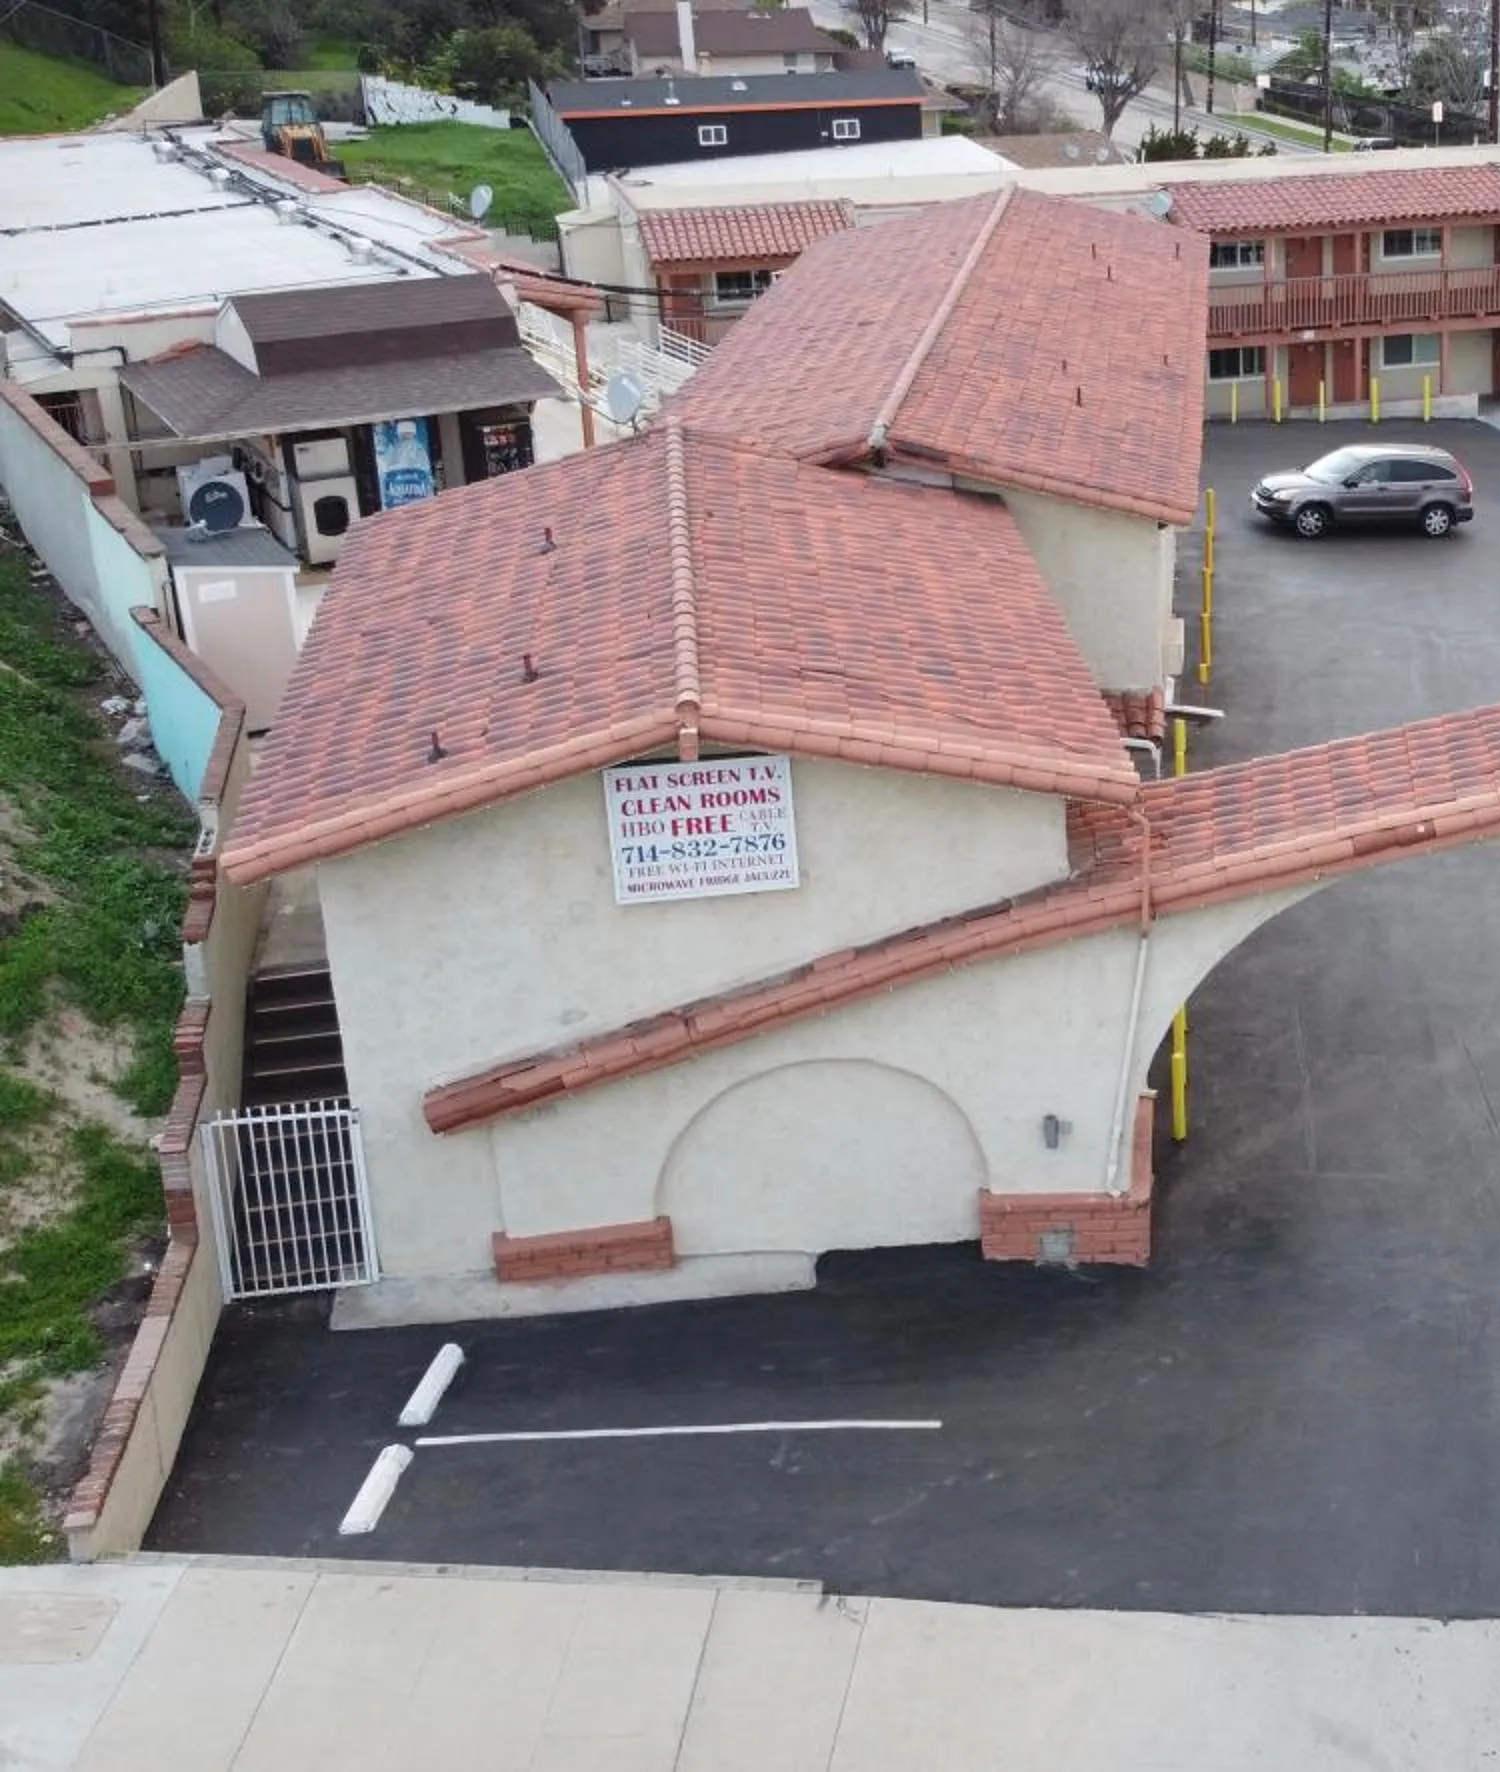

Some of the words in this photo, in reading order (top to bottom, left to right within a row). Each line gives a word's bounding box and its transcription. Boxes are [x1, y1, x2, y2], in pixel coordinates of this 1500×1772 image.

[615, 775, 658, 793] FLAT
[667, 768, 741, 789] SCREEN
[747, 765, 783, 781] T.V.
[621, 794, 691, 817] CLEAN
[700, 787, 781, 809] ROOMS
[621, 820, 665, 839] HBO
[671, 814, 737, 837] FREE
[739, 807, 786, 821] CABLE
[621, 833, 786, 865] 714-832-7876
[628, 864, 665, 879] FREE
[711, 854, 784, 871] INTERNET
[627, 878, 695, 893] MICROWAVE
